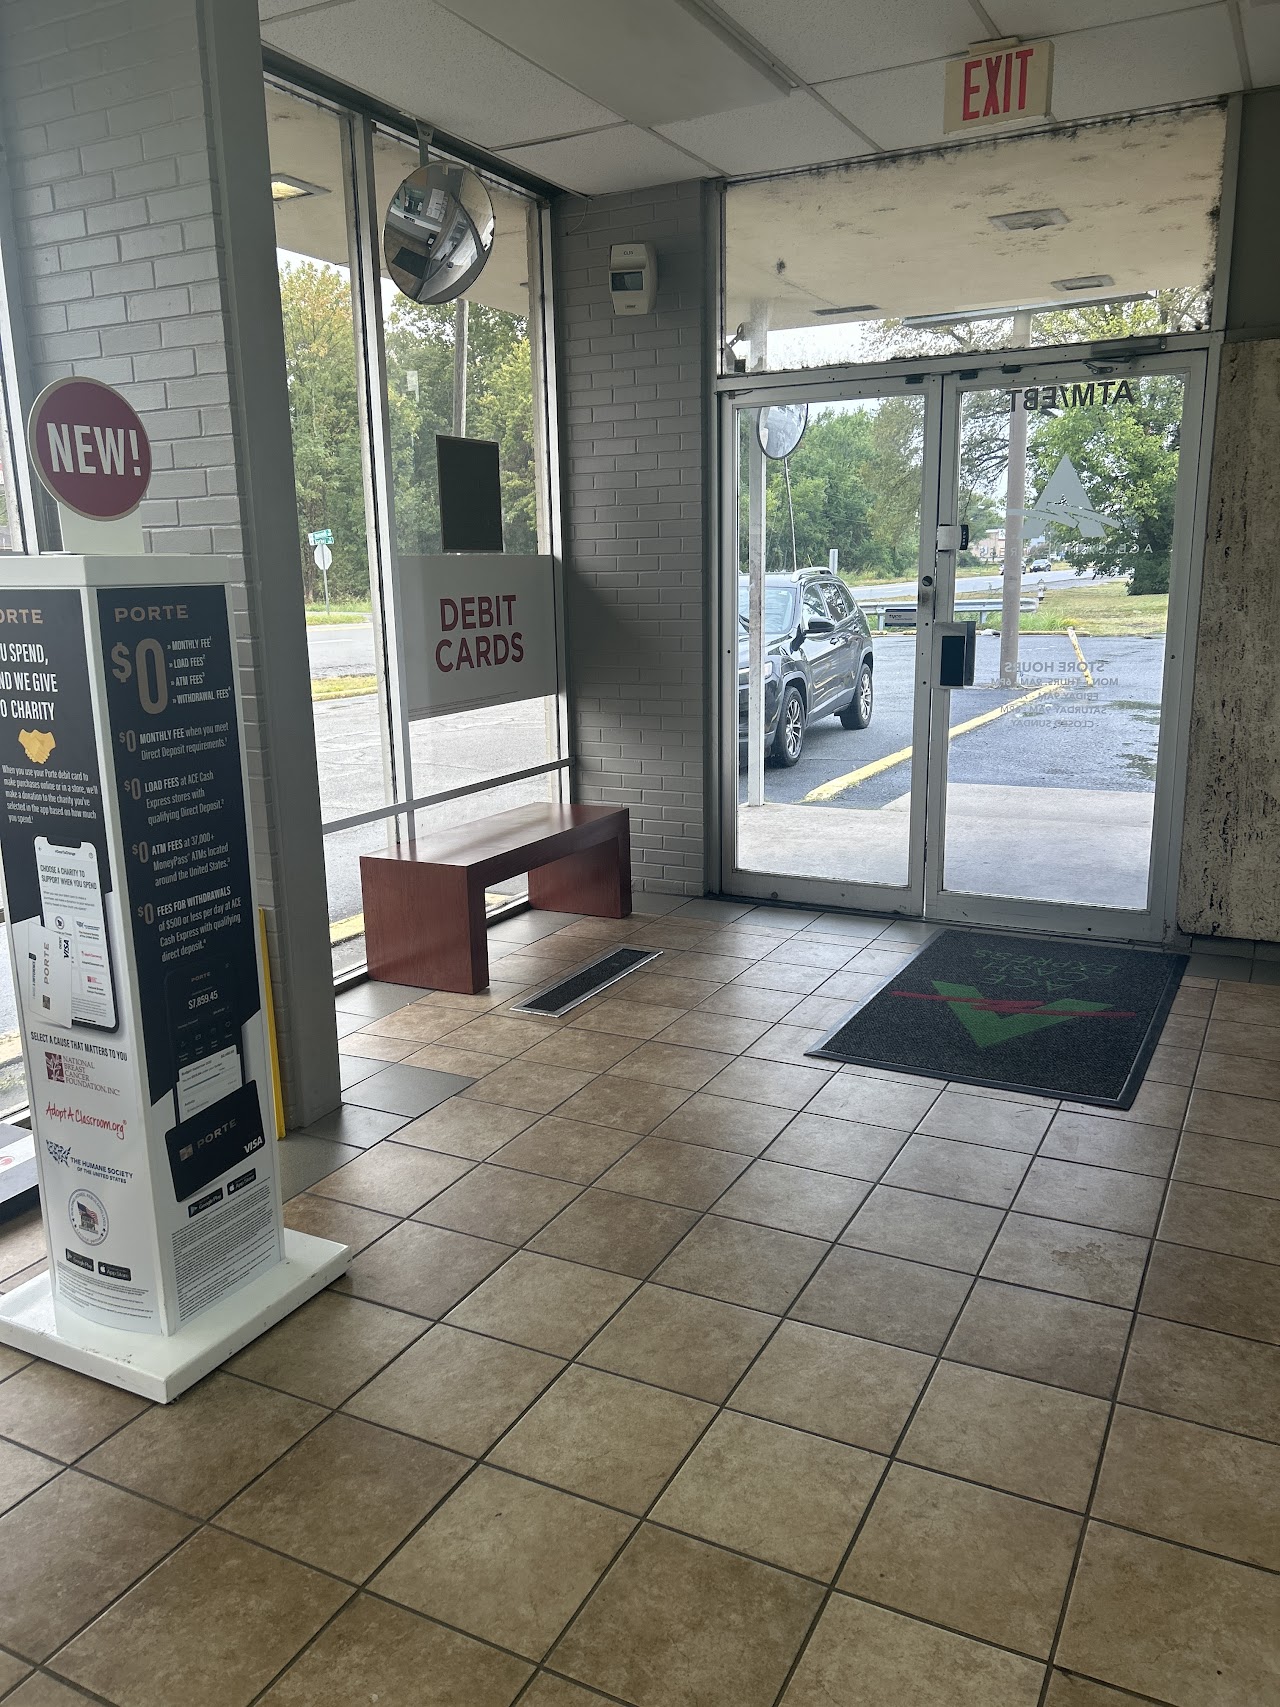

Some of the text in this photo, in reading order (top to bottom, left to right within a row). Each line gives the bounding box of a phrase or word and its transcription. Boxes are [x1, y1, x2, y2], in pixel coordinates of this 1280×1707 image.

[962, 48, 1034, 120] EXIT
[46, 422, 142, 476] NEW!
[114, 604, 189, 623] PORTE
[439, 594, 517, 632] DEBIT
[9, 642, 48, 666] SPEND,
[172, 639, 199, 650] MONTHLY
[435, 632, 524, 672] CARDS
[174, 658, 190, 668] LOAD
[13, 672, 32, 692] WE
[32, 672, 58, 692] GIVE
[111, 638, 168, 714] $0
[176, 676, 188, 686] ATM
[176, 690, 215, 704] WITHDRAWAL
[10, 700, 54, 720] CHARITY
[118, 730, 136, 752] $0
[140, 722, 229, 744] MONTHLY FEE when you meet
[142, 748, 161, 760] Direct
[162, 744, 186, 758] Deposit
[124, 778, 142, 800] $0
[144, 770, 214, 792] LOAD FEES at ACE Cash
[146, 788, 205, 809] Express stores with
[148, 810, 180, 826] qualifying
[180, 805, 198, 817] Direct
[132, 842, 149, 863] $0
[152, 832, 214, 856] ATM FEES at 37,000+
[191, 850, 208, 861] ATMs
[208, 842, 228, 856] located
[40, 864, 56, 874] CHOOSE
[61, 868, 78, 876] CHARITY
[80, 870, 86, 878] TO
[155, 872, 178, 886] around
[178, 870, 188, 880] the
[189, 864, 208, 877] United
[42, 874, 60, 884] SUPPORT
[60, 878, 73, 886] WHEN
[83, 880, 97, 890] SPEND
[157, 886, 231, 916] FEES FOR WITHDRAWALS
[138, 902, 154, 924] $0
[158, 896, 242, 932] of $500 or less per day at ACE
[160, 914, 240, 947] Cash Express with qualifying
[161, 948, 180, 962] direct
[973, 950, 1118, 975] EXPRESS
[191, 971, 210, 982] PORTE
[981, 974, 1074, 990] ACE
[983, 962, 1088, 982] CASH
[188, 990, 218, 1010] $7,859.45
[31, 1032, 128, 1061] SELECT A CAUSE THAT MATTERS TO YOU
[63, 1056, 95, 1069] NATIONAL
[64, 1063, 86, 1074] BREAST
[64, 1070, 90, 1081] CANCER
[196, 1118, 237, 1148] PORTE
[243, 1136, 262, 1154] VISA
[70, 1156, 133, 1178] THE HUMANE SOCIETY
[92, 1170, 109, 1180] UNITED
[110, 1176, 126, 1184] STATES
